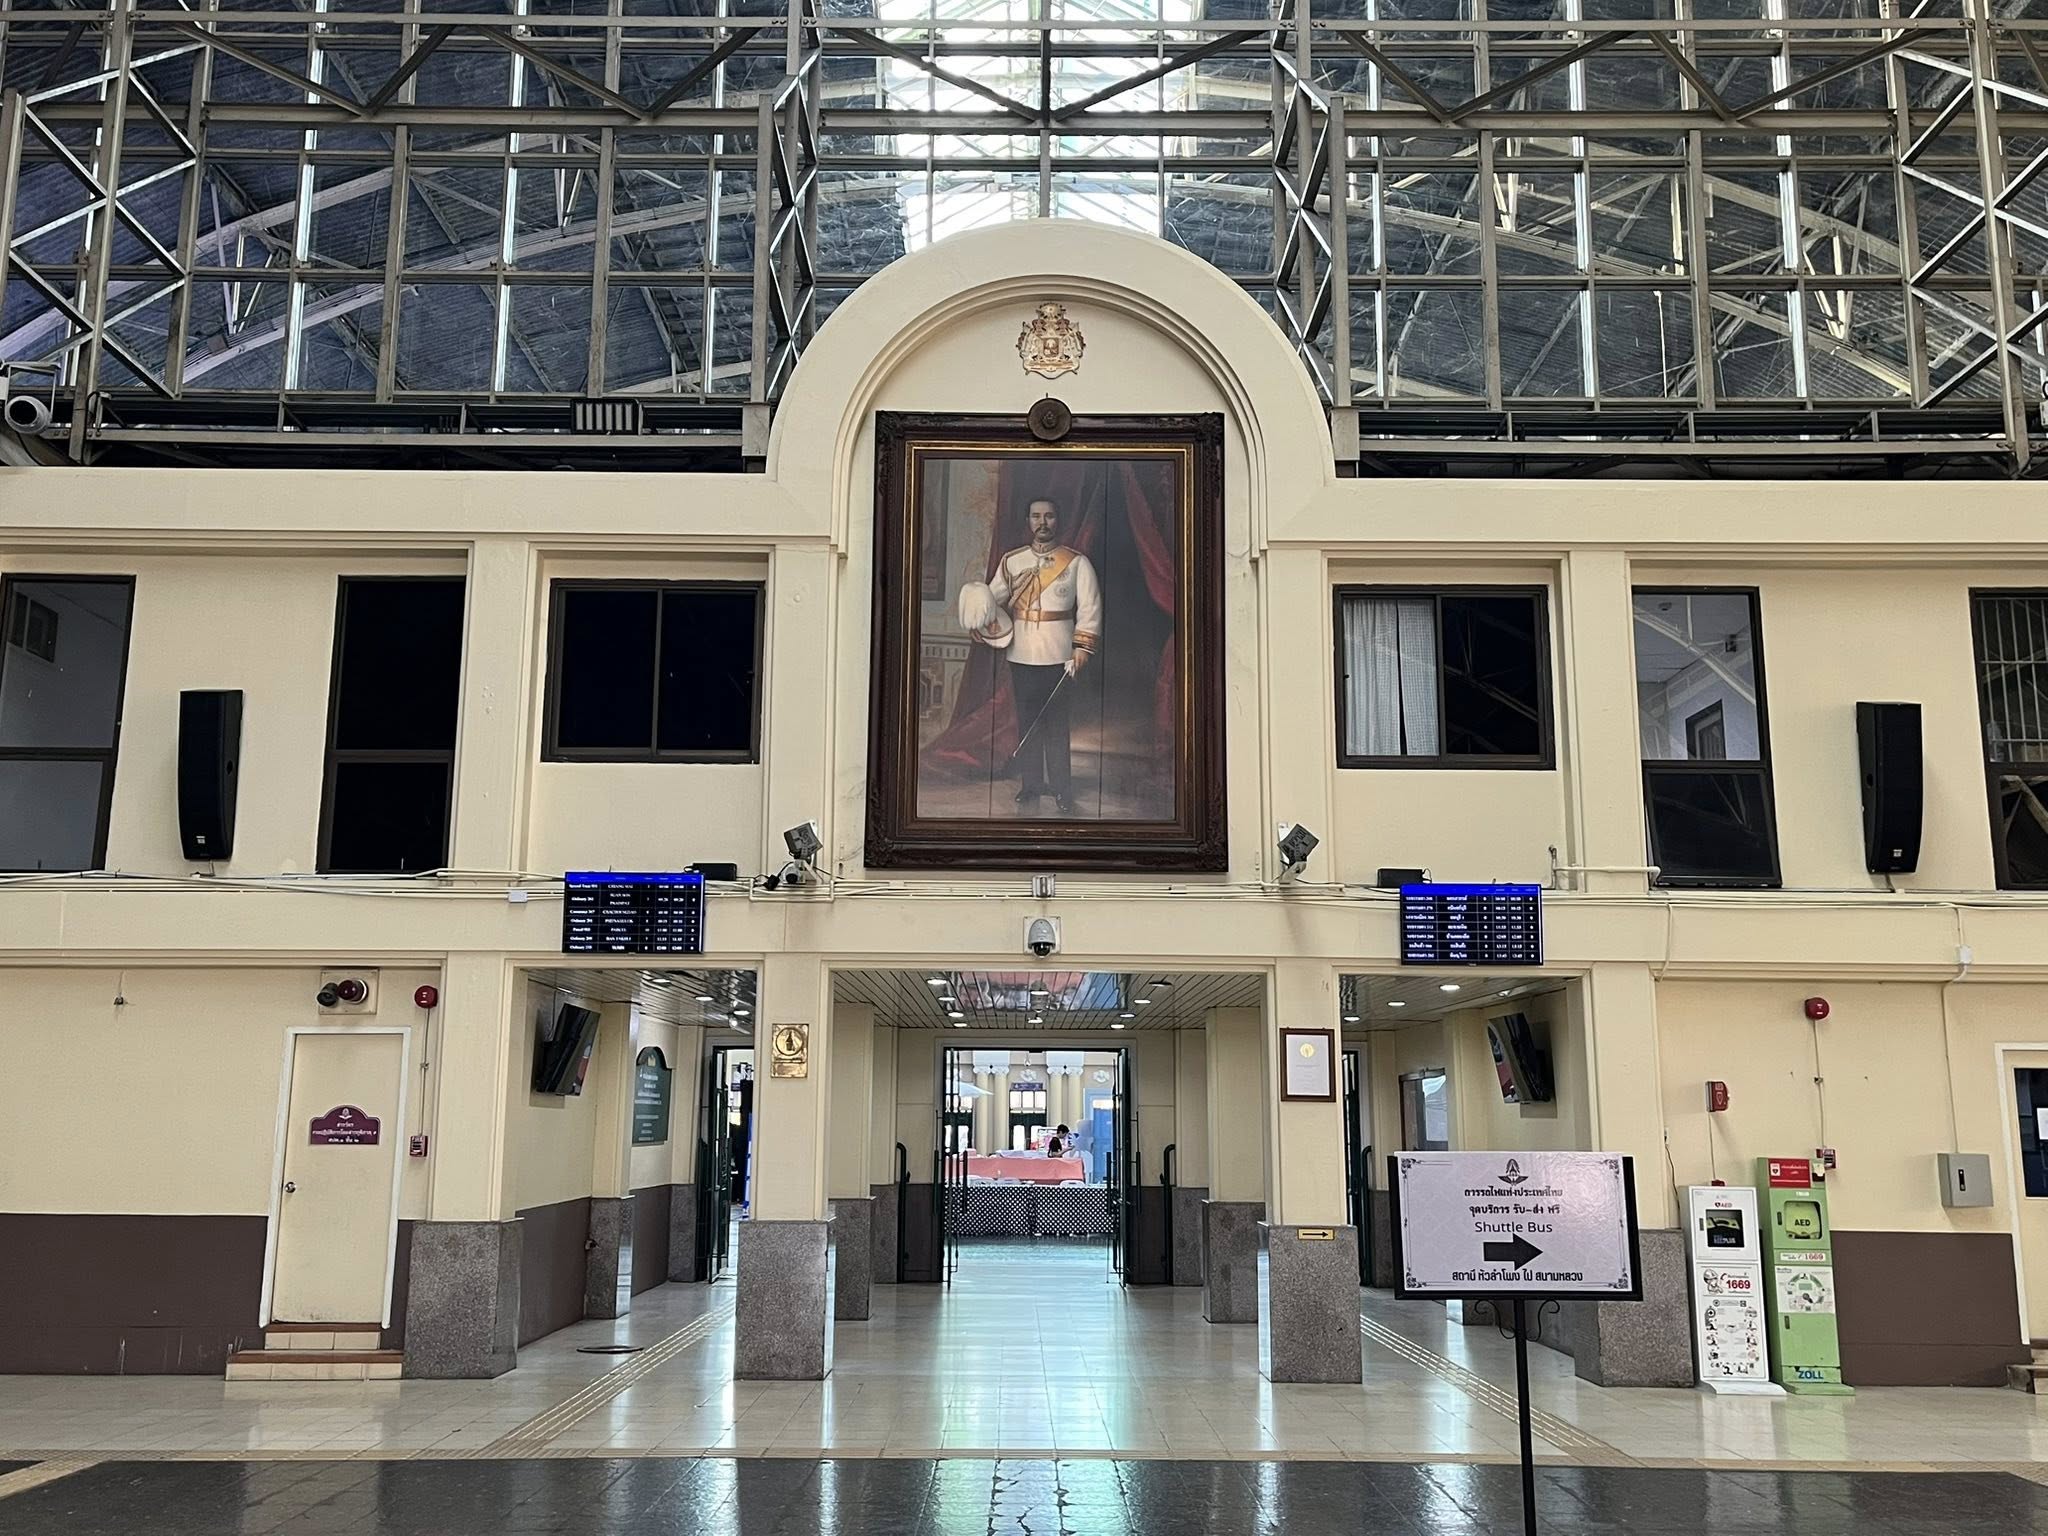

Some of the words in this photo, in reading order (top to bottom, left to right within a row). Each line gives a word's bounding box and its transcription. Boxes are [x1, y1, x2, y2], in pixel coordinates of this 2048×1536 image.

[1469, 1204, 1510, 1218] จุดบริการ
[1475, 1221, 1523, 1233] Shuttle
[1528, 1221, 1553, 1233] Bus
[1794, 1218, 1811, 1227] AED
[1804, 1252, 1824, 1261] 1669
[1452, 1269, 1476, 1281] สถานี
[1478, 1268, 1521, 1281] หัวลำโพง
[1523, 1268, 1533, 1281] ไป
[1536, 1271, 1583, 1282] สนามหลวง
[1726, 1279, 1751, 1289] 1669
[1798, 1370, 1824, 1379] ZOLL
